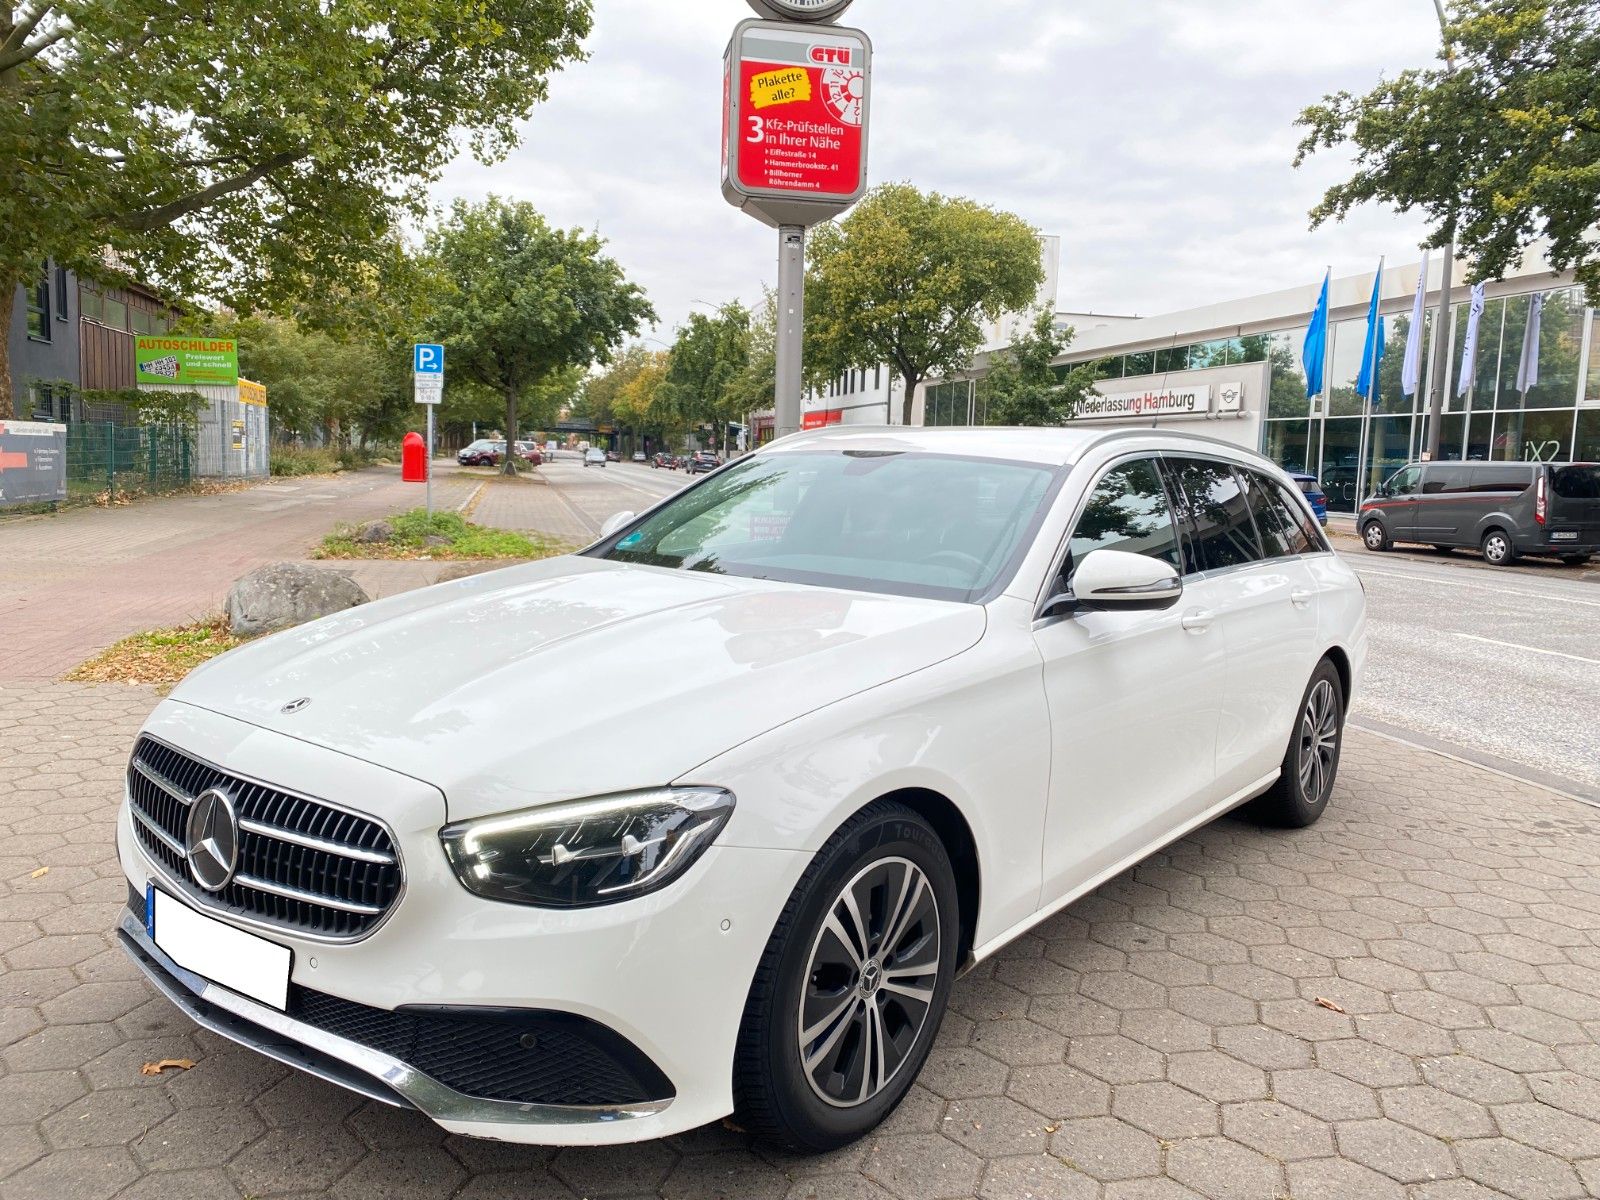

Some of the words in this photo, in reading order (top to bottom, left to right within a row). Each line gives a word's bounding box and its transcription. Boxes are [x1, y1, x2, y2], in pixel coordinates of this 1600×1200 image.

[810, 46, 850, 64] GTÜ
[757, 72, 803, 89] Plakette
[771, 87, 796, 102] alle?
[746, 115, 764, 143] 3
[766, 118, 844, 136] Kfz-Prüfstellen
[765, 132, 777, 144] in
[779, 133, 808, 147] Ihrer
[809, 136, 841, 150] Nähe
[769, 148, 807, 159] Eiffestraße
[769, 159, 830, 171] Hammerbrookstr.
[830, 163, 839, 171] 41
[769, 169, 803, 178] Billhorner
[768, 178, 815, 188] Röhrendamm
[138, 339, 234, 352] AUTOSCHILDER
[185, 353, 225, 361] Preiswert
[419, 347, 435, 370] P
[1075, 397, 1141, 415] Niederlassung
[1144, 391, 1195, 411] Hamburg
